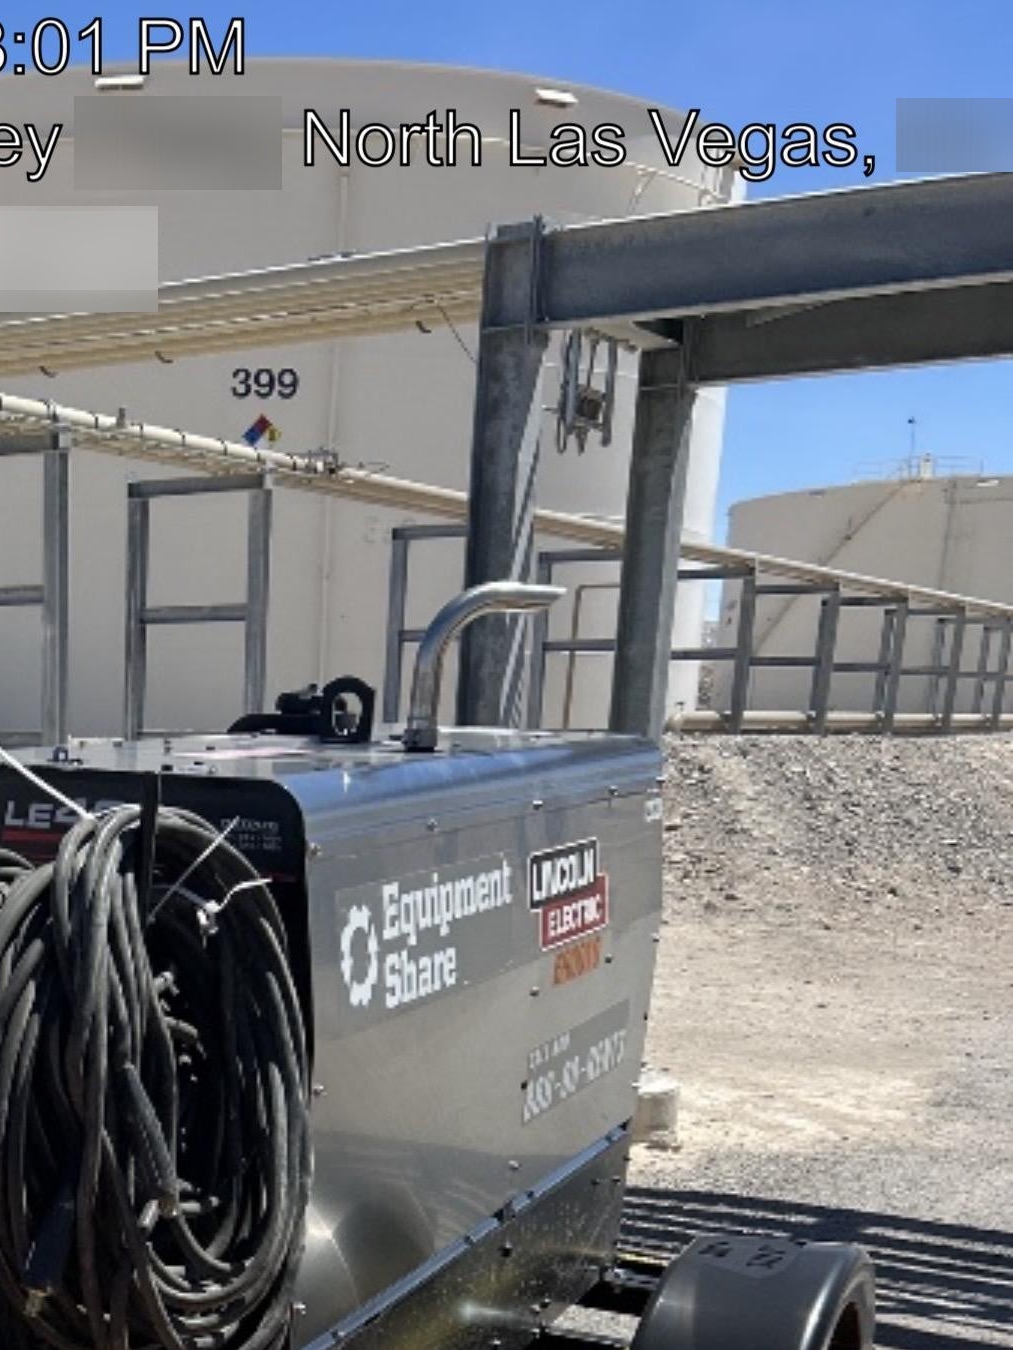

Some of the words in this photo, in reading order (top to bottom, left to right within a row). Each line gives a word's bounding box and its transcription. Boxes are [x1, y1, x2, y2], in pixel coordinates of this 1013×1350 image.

[231, 368, 300, 399] 399
[532, 847, 595, 901] LINCOLN
[382, 859, 513, 946] Equipment
[548, 892, 604, 938] ELECTRIC
[385, 945, 458, 1009] Share
